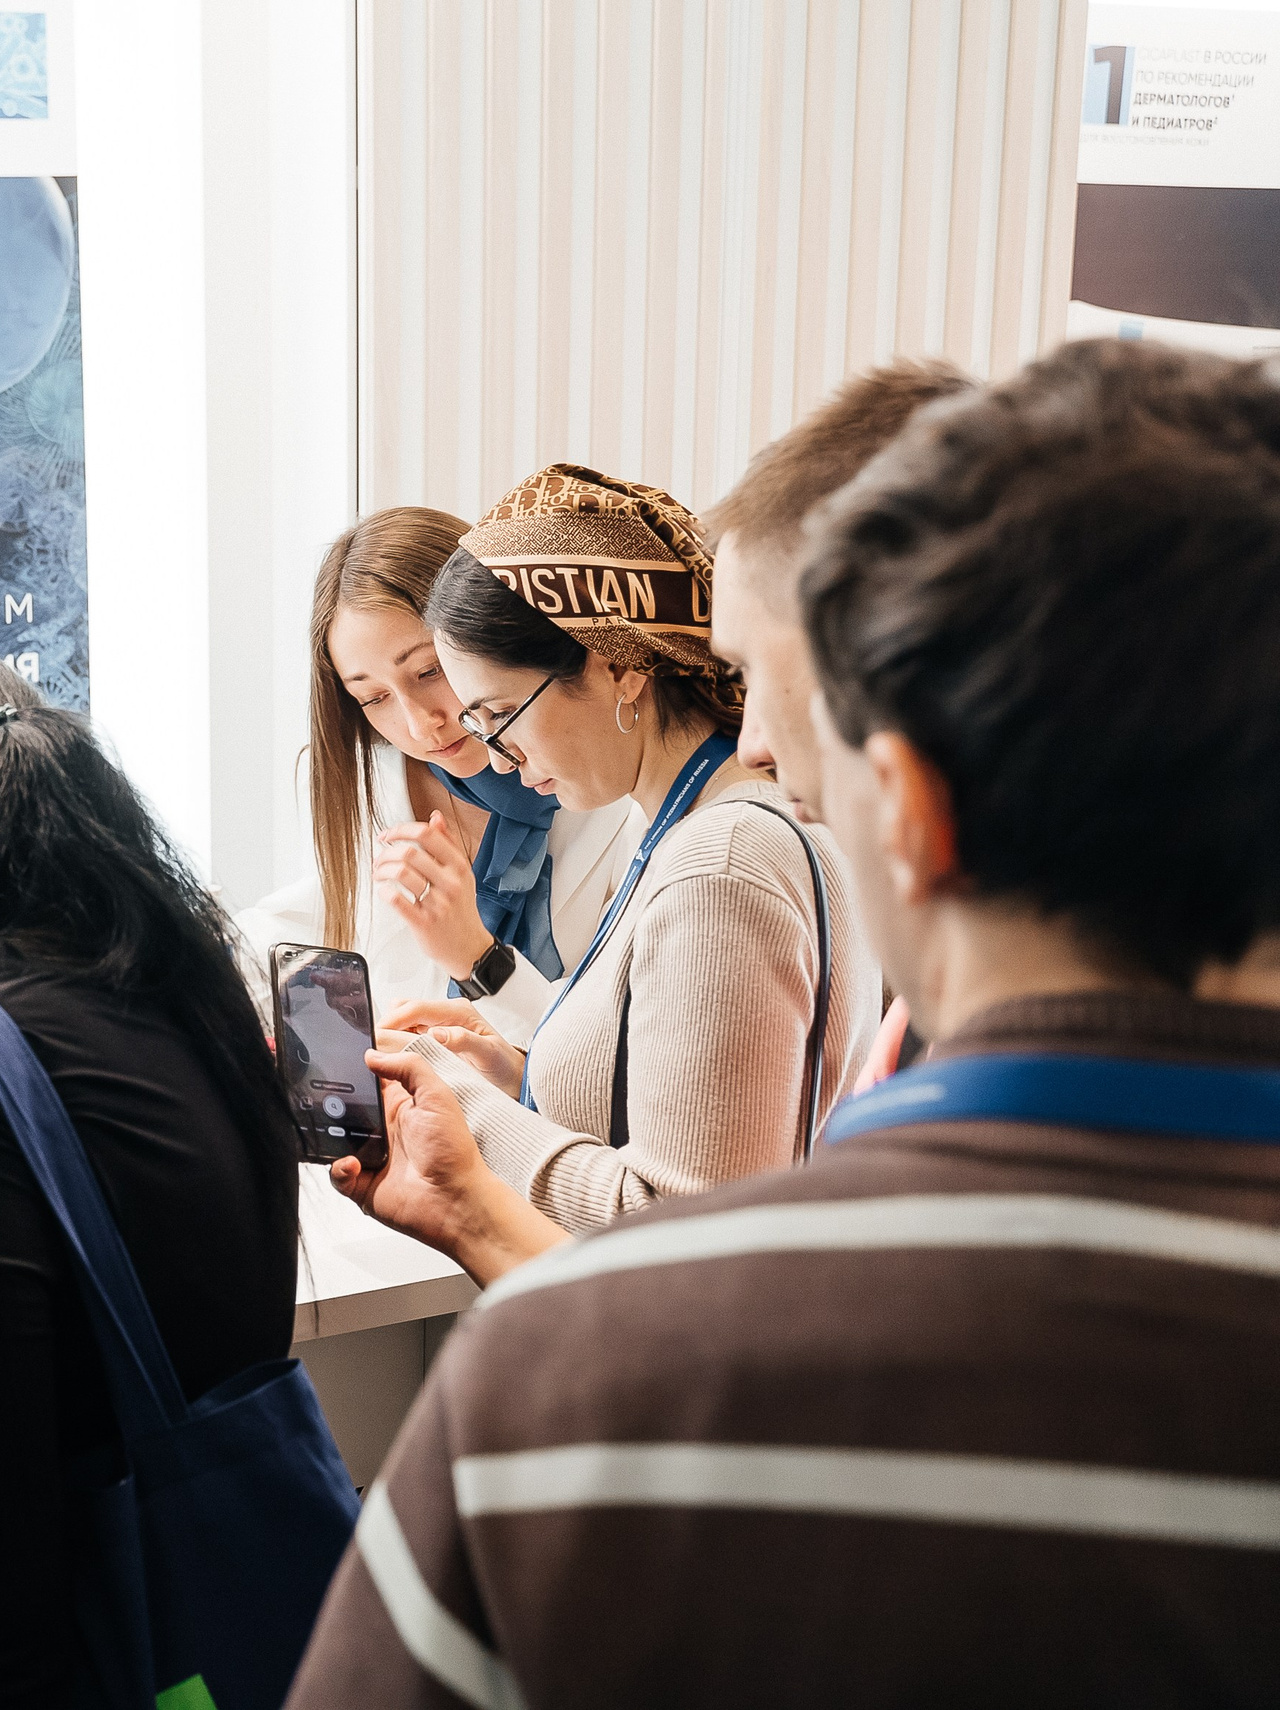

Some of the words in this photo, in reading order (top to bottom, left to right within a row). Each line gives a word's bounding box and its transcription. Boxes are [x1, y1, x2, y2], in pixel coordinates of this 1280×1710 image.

[1203, 50, 1212, 63] В
[1214, 51, 1267, 65] РОССИИ
[1135, 70, 1154, 85] ПО
[1157, 71, 1255, 88] РЕКОМЕНДАЦИИ
[1131, 116, 1139, 127] И
[693, 759, 709, 777] RUSSIA
